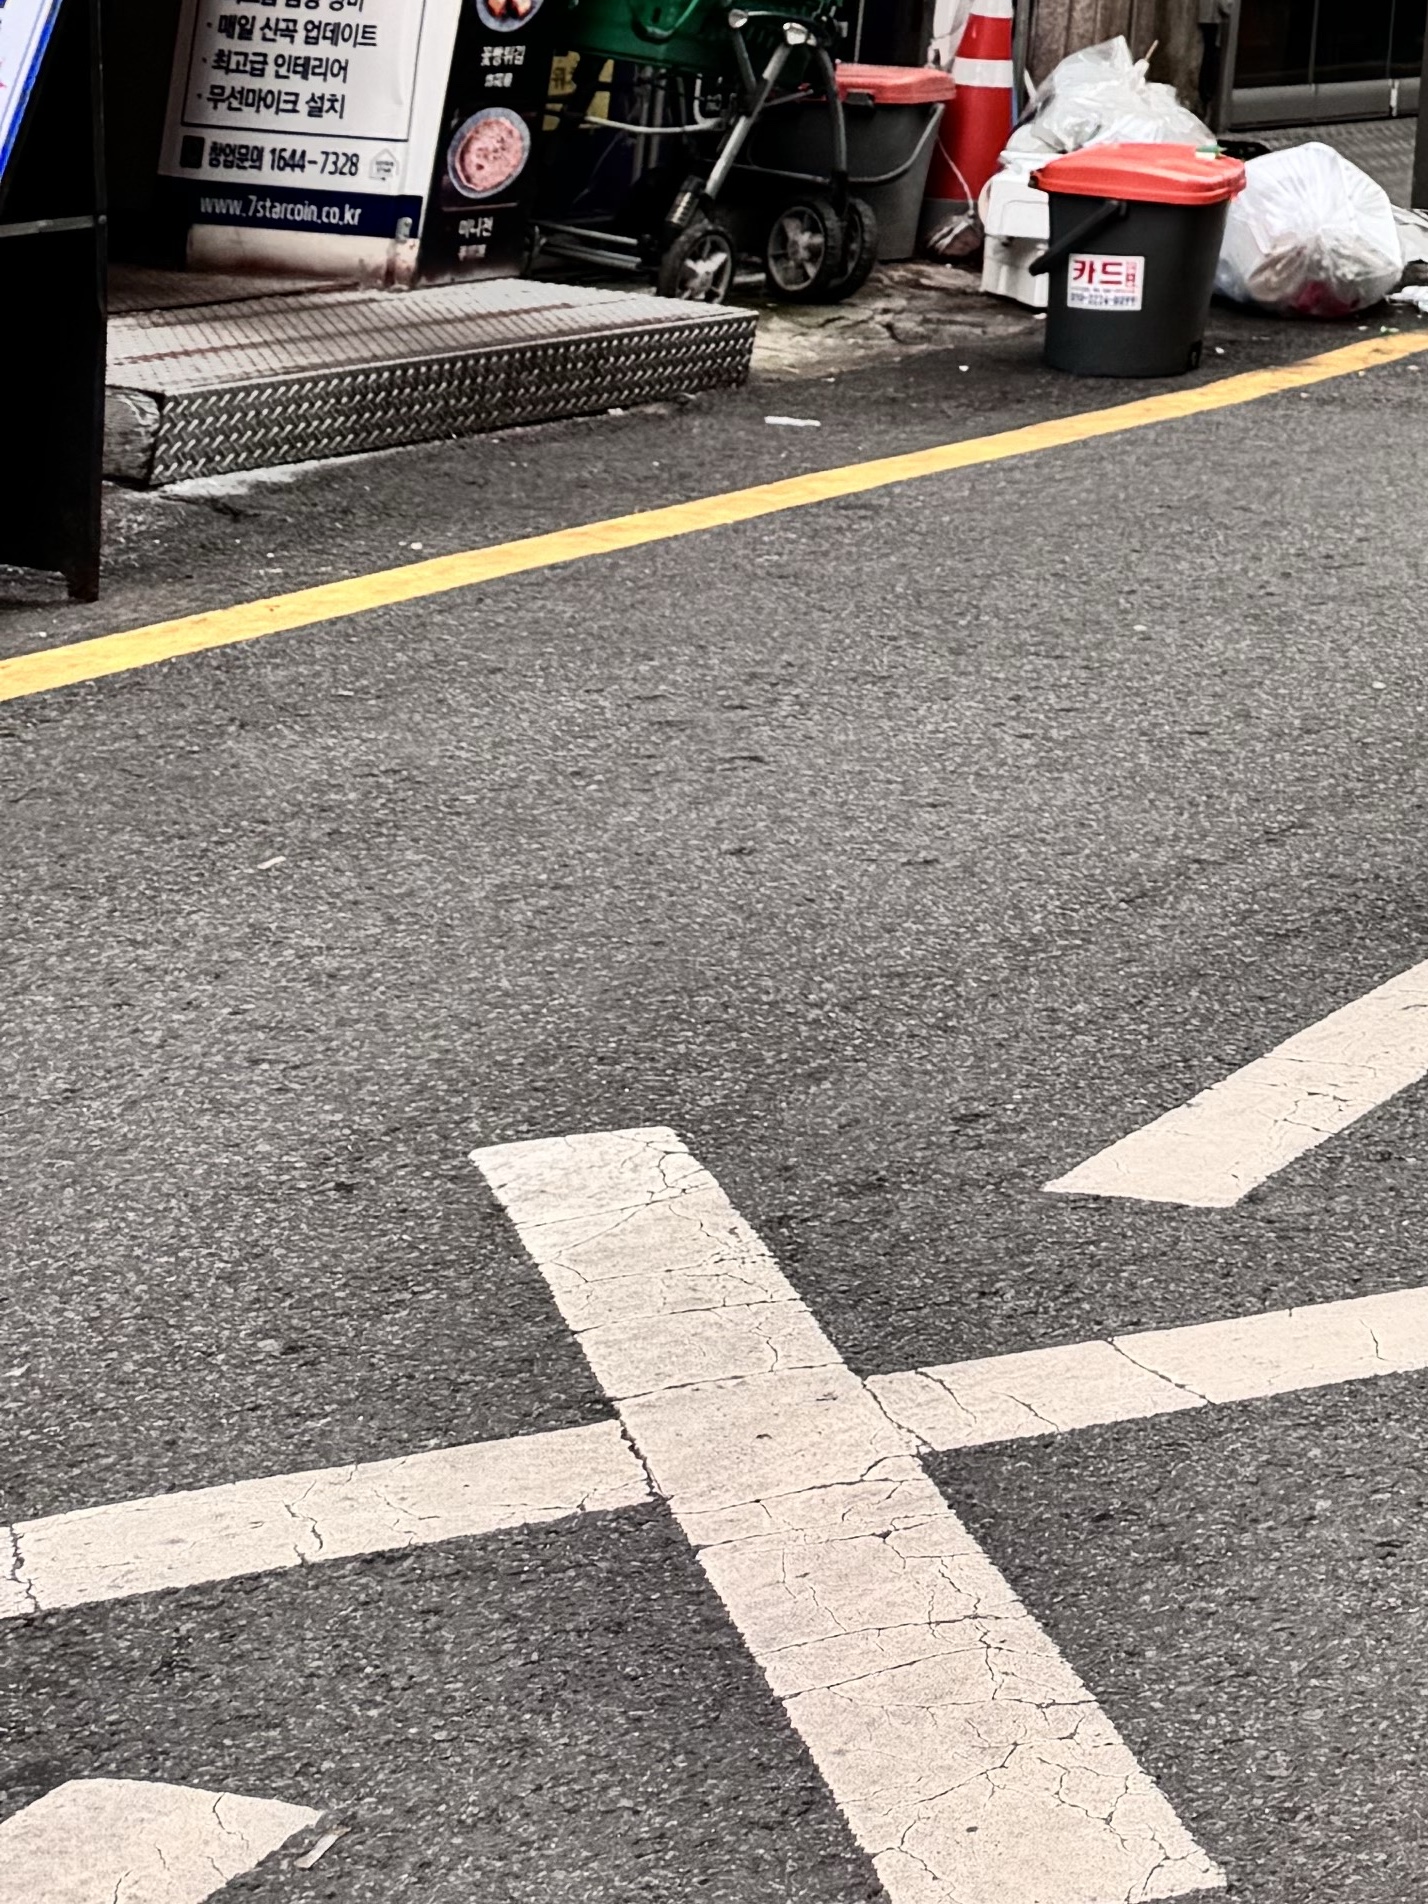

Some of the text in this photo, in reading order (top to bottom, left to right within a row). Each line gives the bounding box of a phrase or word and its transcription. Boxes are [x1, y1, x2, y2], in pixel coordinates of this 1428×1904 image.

[218, 15, 377, 48] 매일 신곡 업데이트
[212, 49, 349, 82] 최고급 인테리어
[207, 83, 345, 119] 무선마이크 설치
[269, 146, 360, 177] 1644-7328
[1072, 260, 1123, 285] 카드
